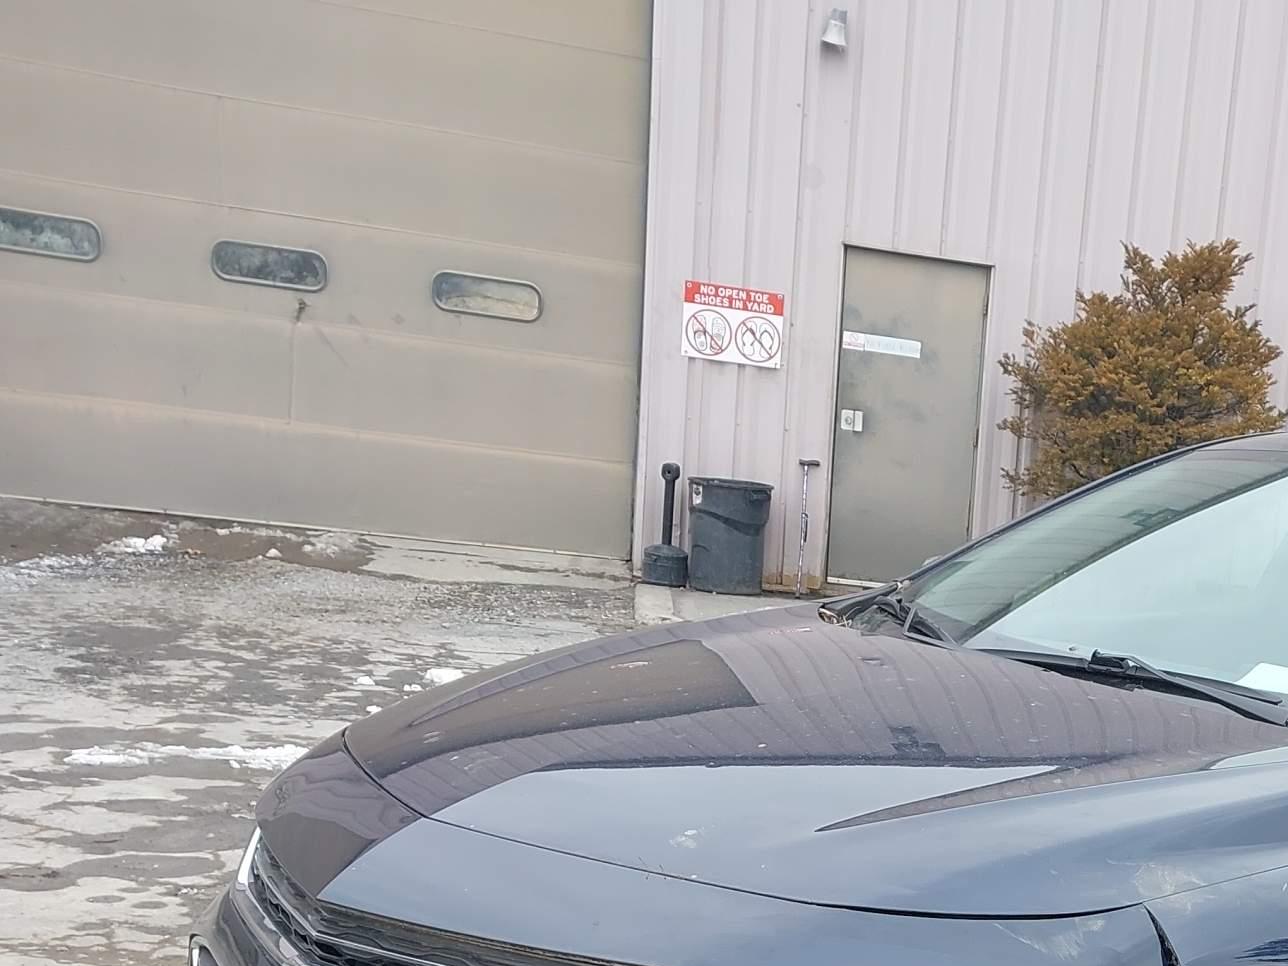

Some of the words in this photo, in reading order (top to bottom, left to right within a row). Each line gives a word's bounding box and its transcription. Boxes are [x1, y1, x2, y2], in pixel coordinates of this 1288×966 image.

[693, 293, 729, 307] SHOES
[732, 298, 744, 309] IN
[746, 300, 775, 314] YARD
[700, 284, 716, 295] NO
[718, 287, 747, 300] OPEN
[749, 291, 769, 303] TOE
